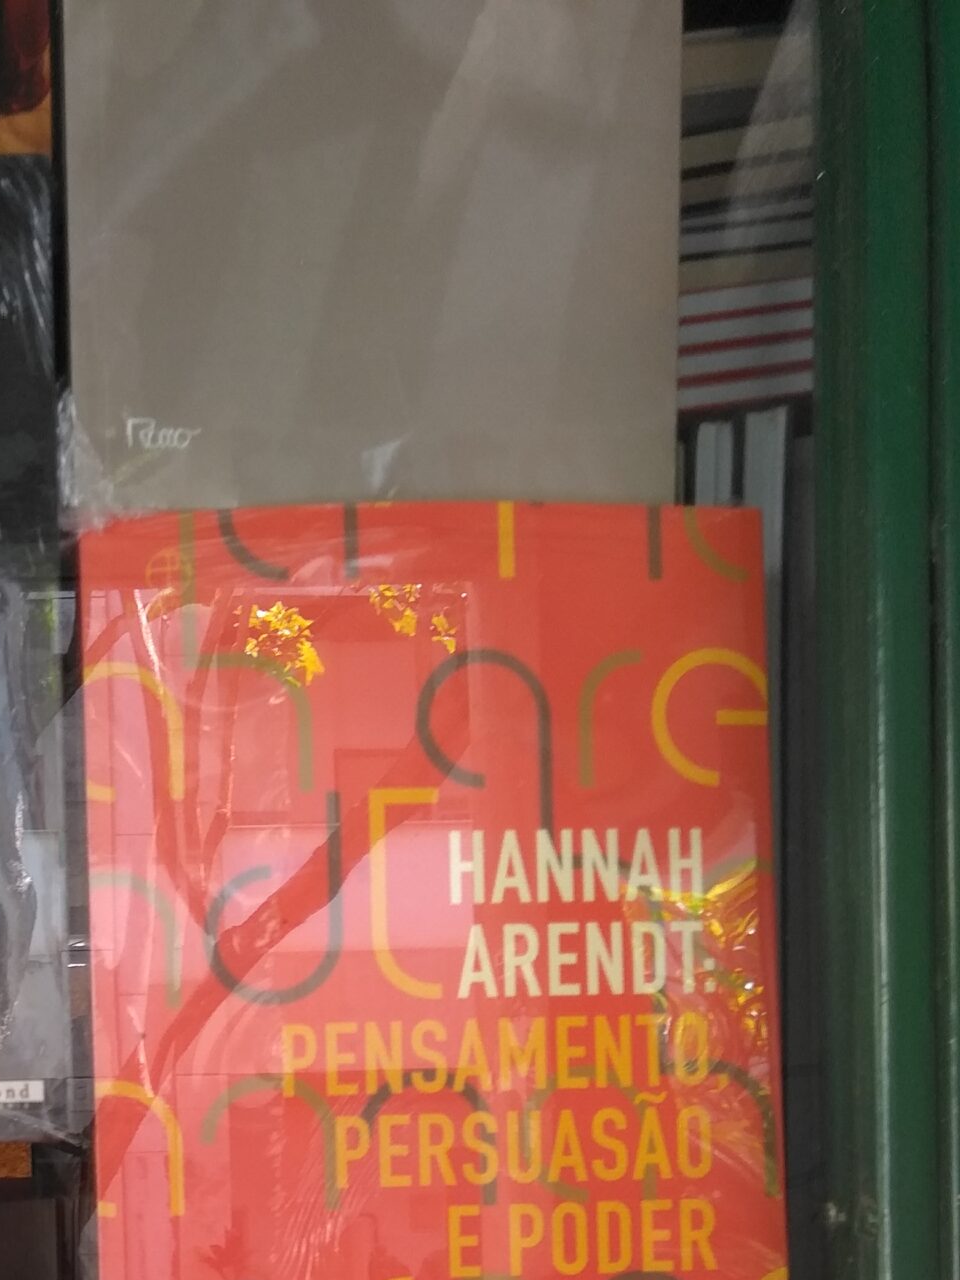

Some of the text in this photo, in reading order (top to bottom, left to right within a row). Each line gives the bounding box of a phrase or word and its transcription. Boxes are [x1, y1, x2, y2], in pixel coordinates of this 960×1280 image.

[449, 828, 704, 906] HANNAH
[457, 921, 716, 999] ARENDT:
[334, 1092, 712, 1190] PERSUASÃO
[447, 1199, 719, 1279] E PODER
